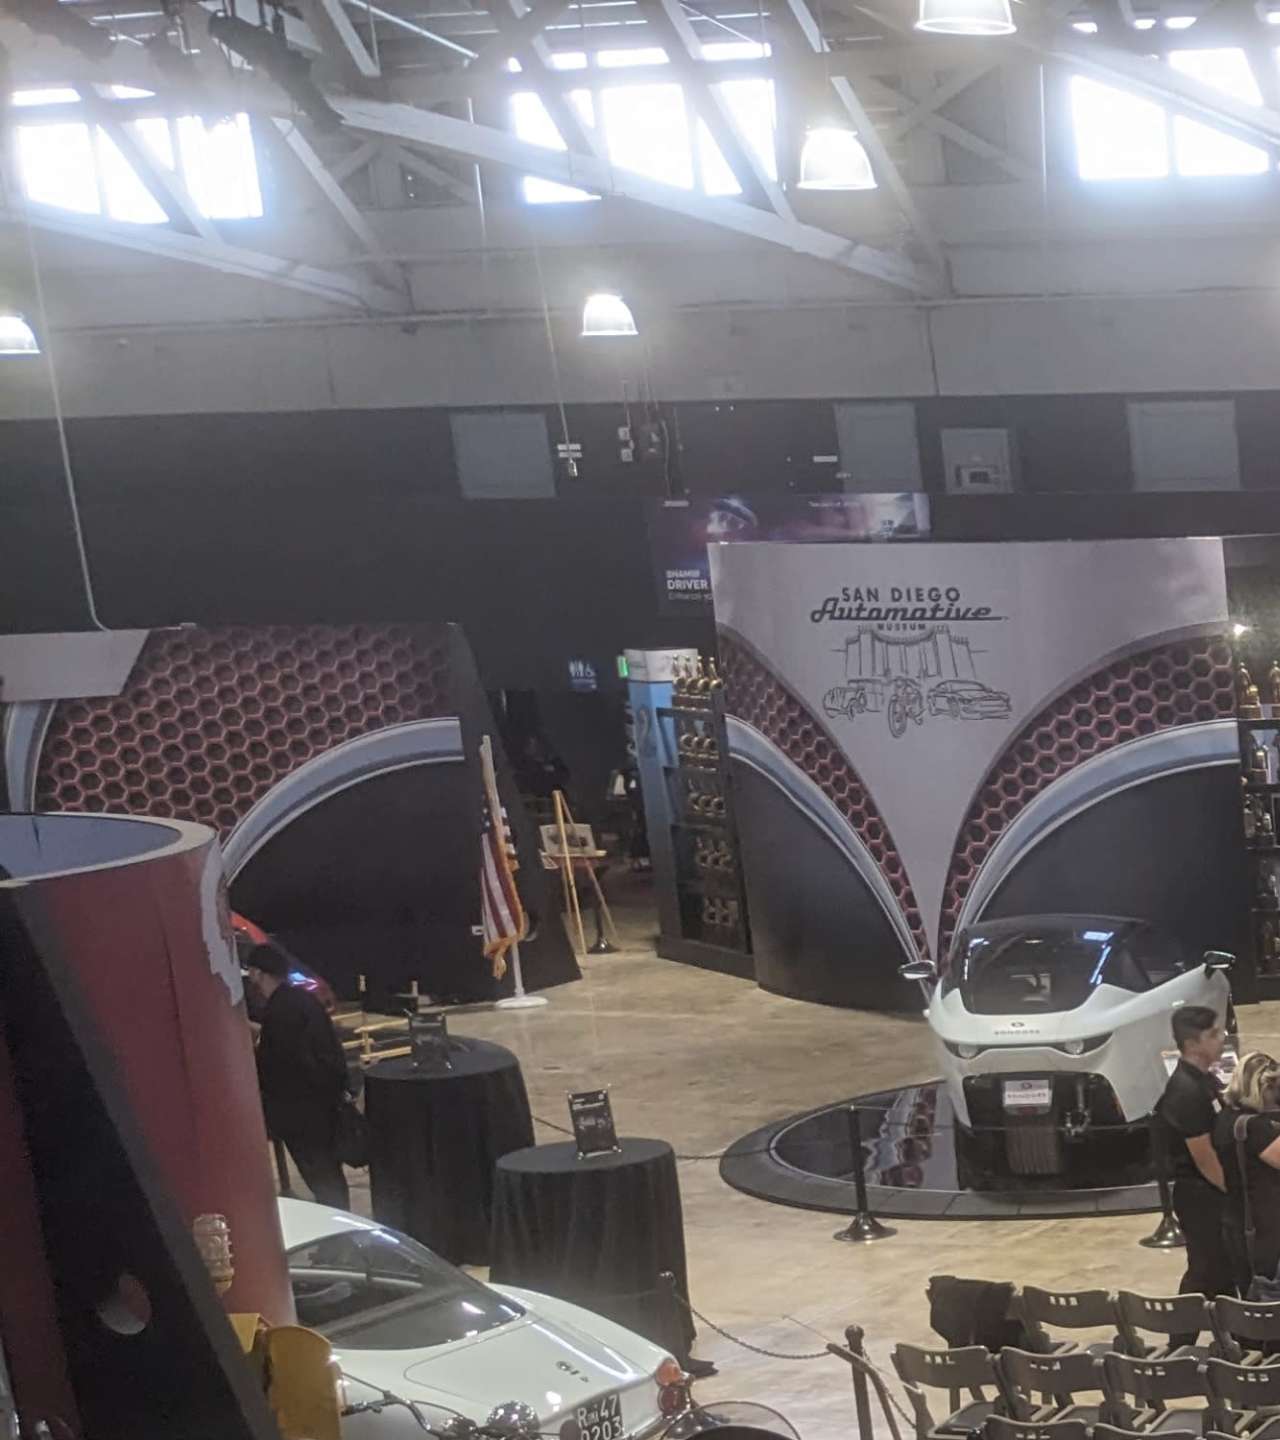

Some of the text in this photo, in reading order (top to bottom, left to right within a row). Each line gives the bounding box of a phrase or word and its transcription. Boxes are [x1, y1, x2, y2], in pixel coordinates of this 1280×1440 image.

[667, 579, 708, 590] DRIVER
[841, 586, 961, 602] SAN DIEGO
[810, 597, 1008, 623] Automotive
[877, 623, 927, 631] MUSEUM
